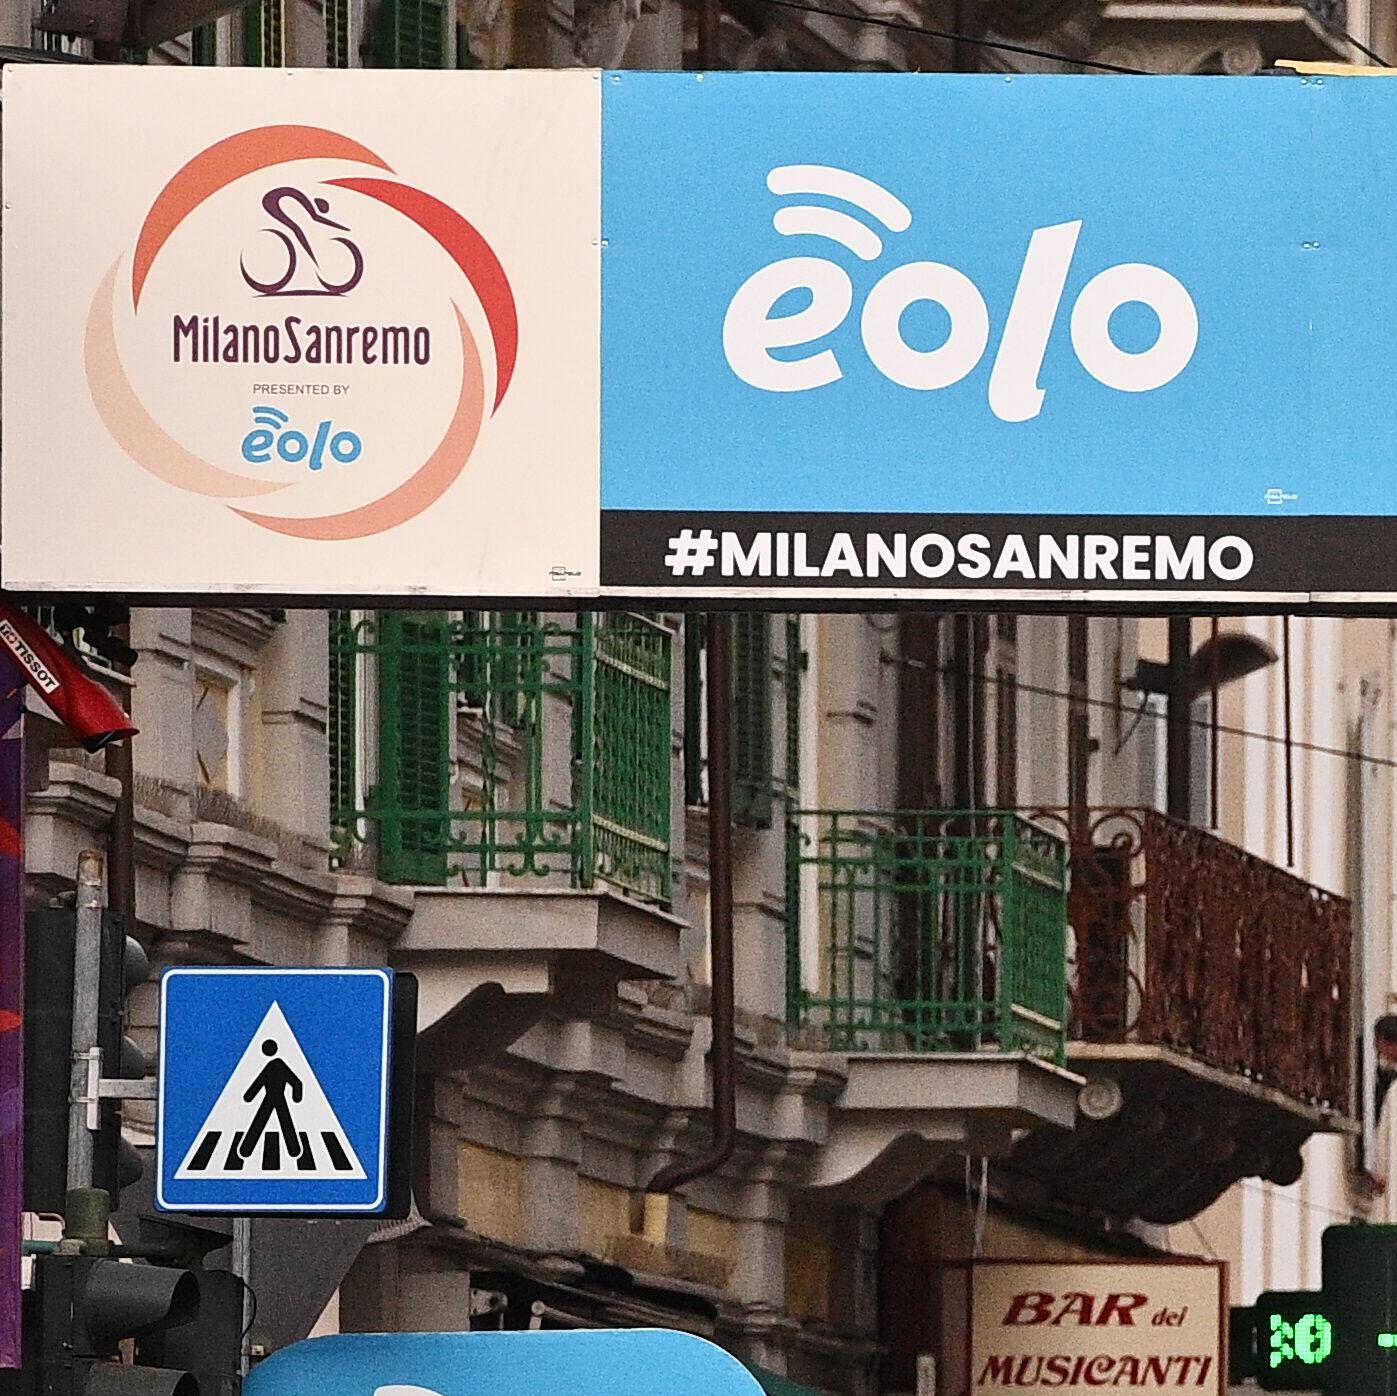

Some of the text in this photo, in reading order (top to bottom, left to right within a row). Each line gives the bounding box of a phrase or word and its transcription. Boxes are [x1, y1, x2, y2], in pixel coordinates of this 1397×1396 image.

[173, 315, 430, 366] MilanoSanremo
[723, 220, 1198, 422] eolo
[252, 383, 351, 395] PRESENTED BY
[242, 421, 363, 470] eolo
[664, 530, 1254, 581] #MILANOSANREMO
[1003, 1291, 1148, 1326] BAR
